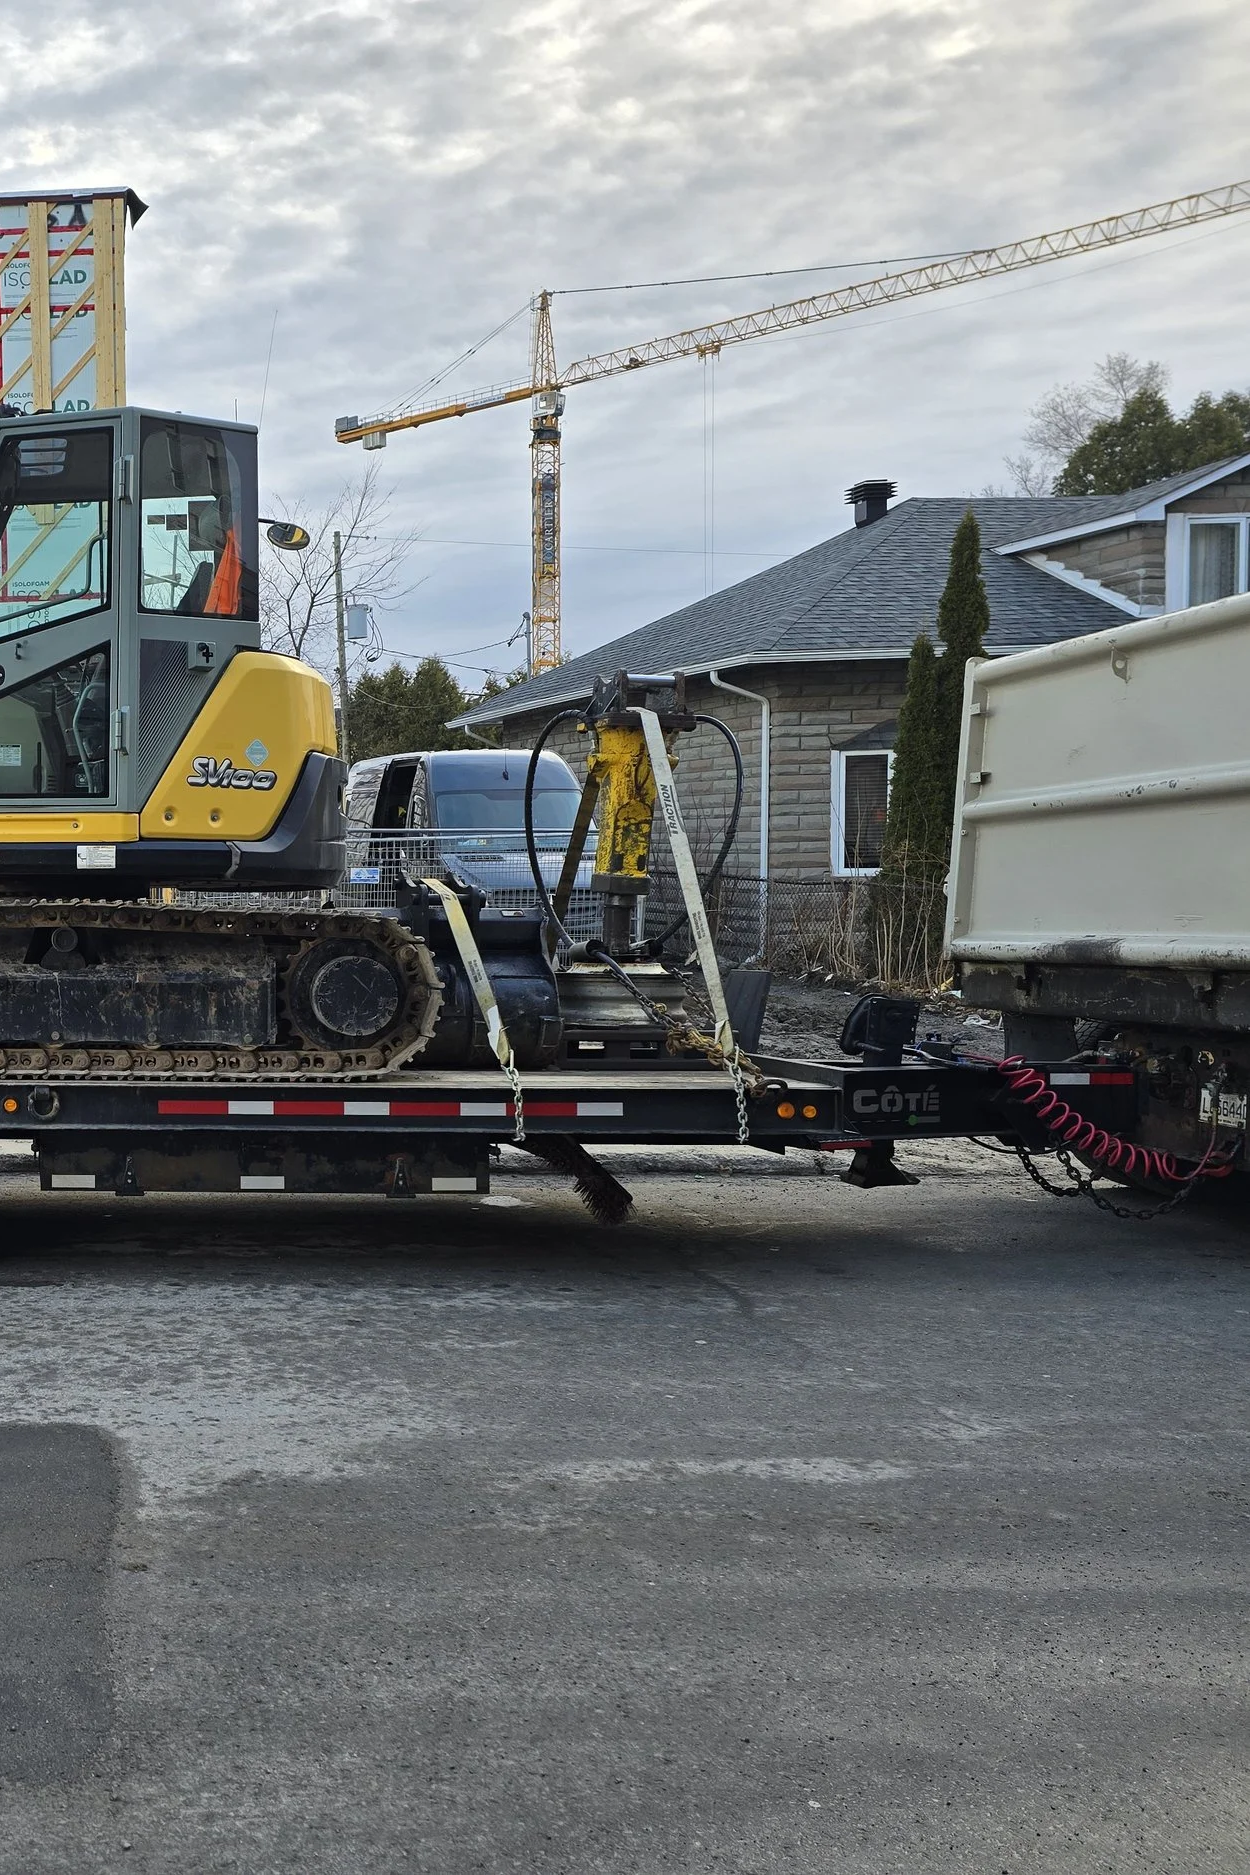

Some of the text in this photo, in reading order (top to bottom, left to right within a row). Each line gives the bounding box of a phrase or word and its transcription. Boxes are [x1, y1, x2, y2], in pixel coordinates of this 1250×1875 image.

[544, 500, 554, 552] CARTIER
[187, 756, 278, 791] SV100
[852, 1084, 940, 1114] CÔTÉ
